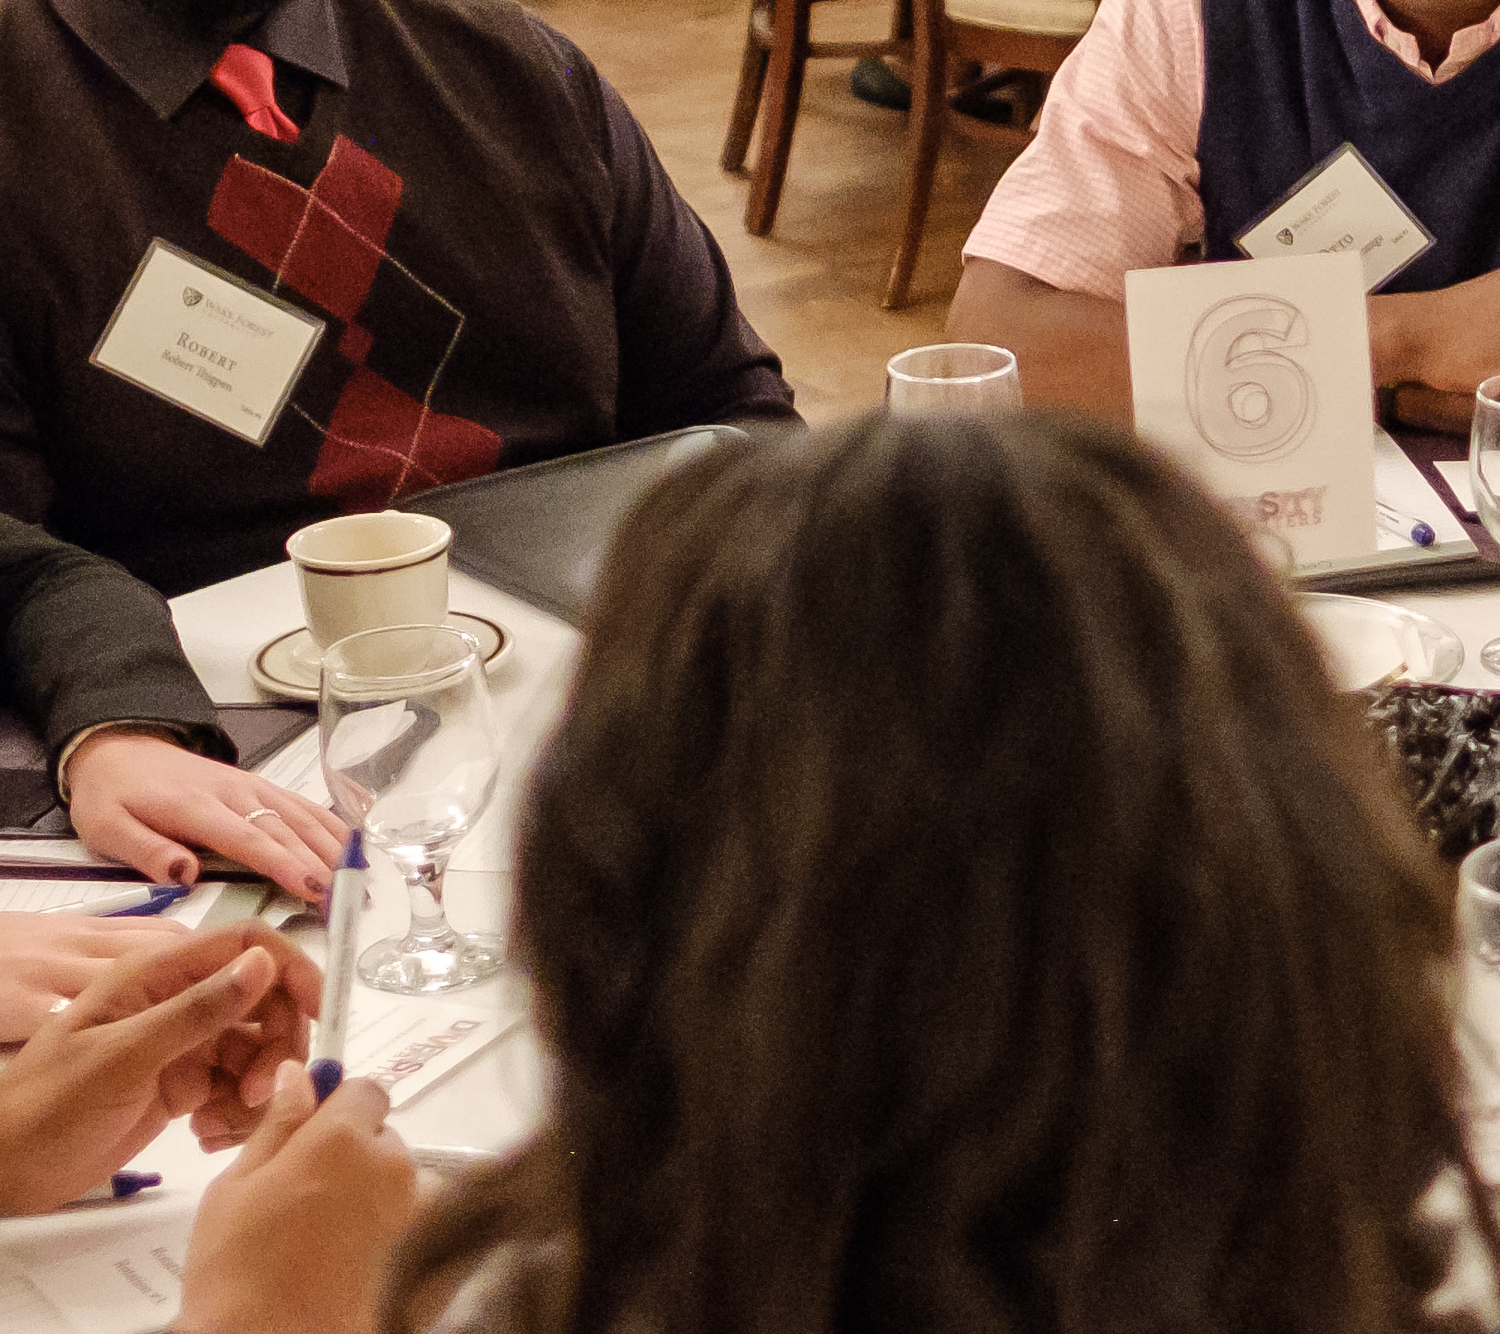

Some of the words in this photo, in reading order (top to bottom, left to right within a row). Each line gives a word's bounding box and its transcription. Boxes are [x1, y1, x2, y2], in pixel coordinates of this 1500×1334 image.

[161, 349, 194, 371] Robert
[176, 332, 238, 372] ROBERT
[1185, 293, 1316, 464] 6
